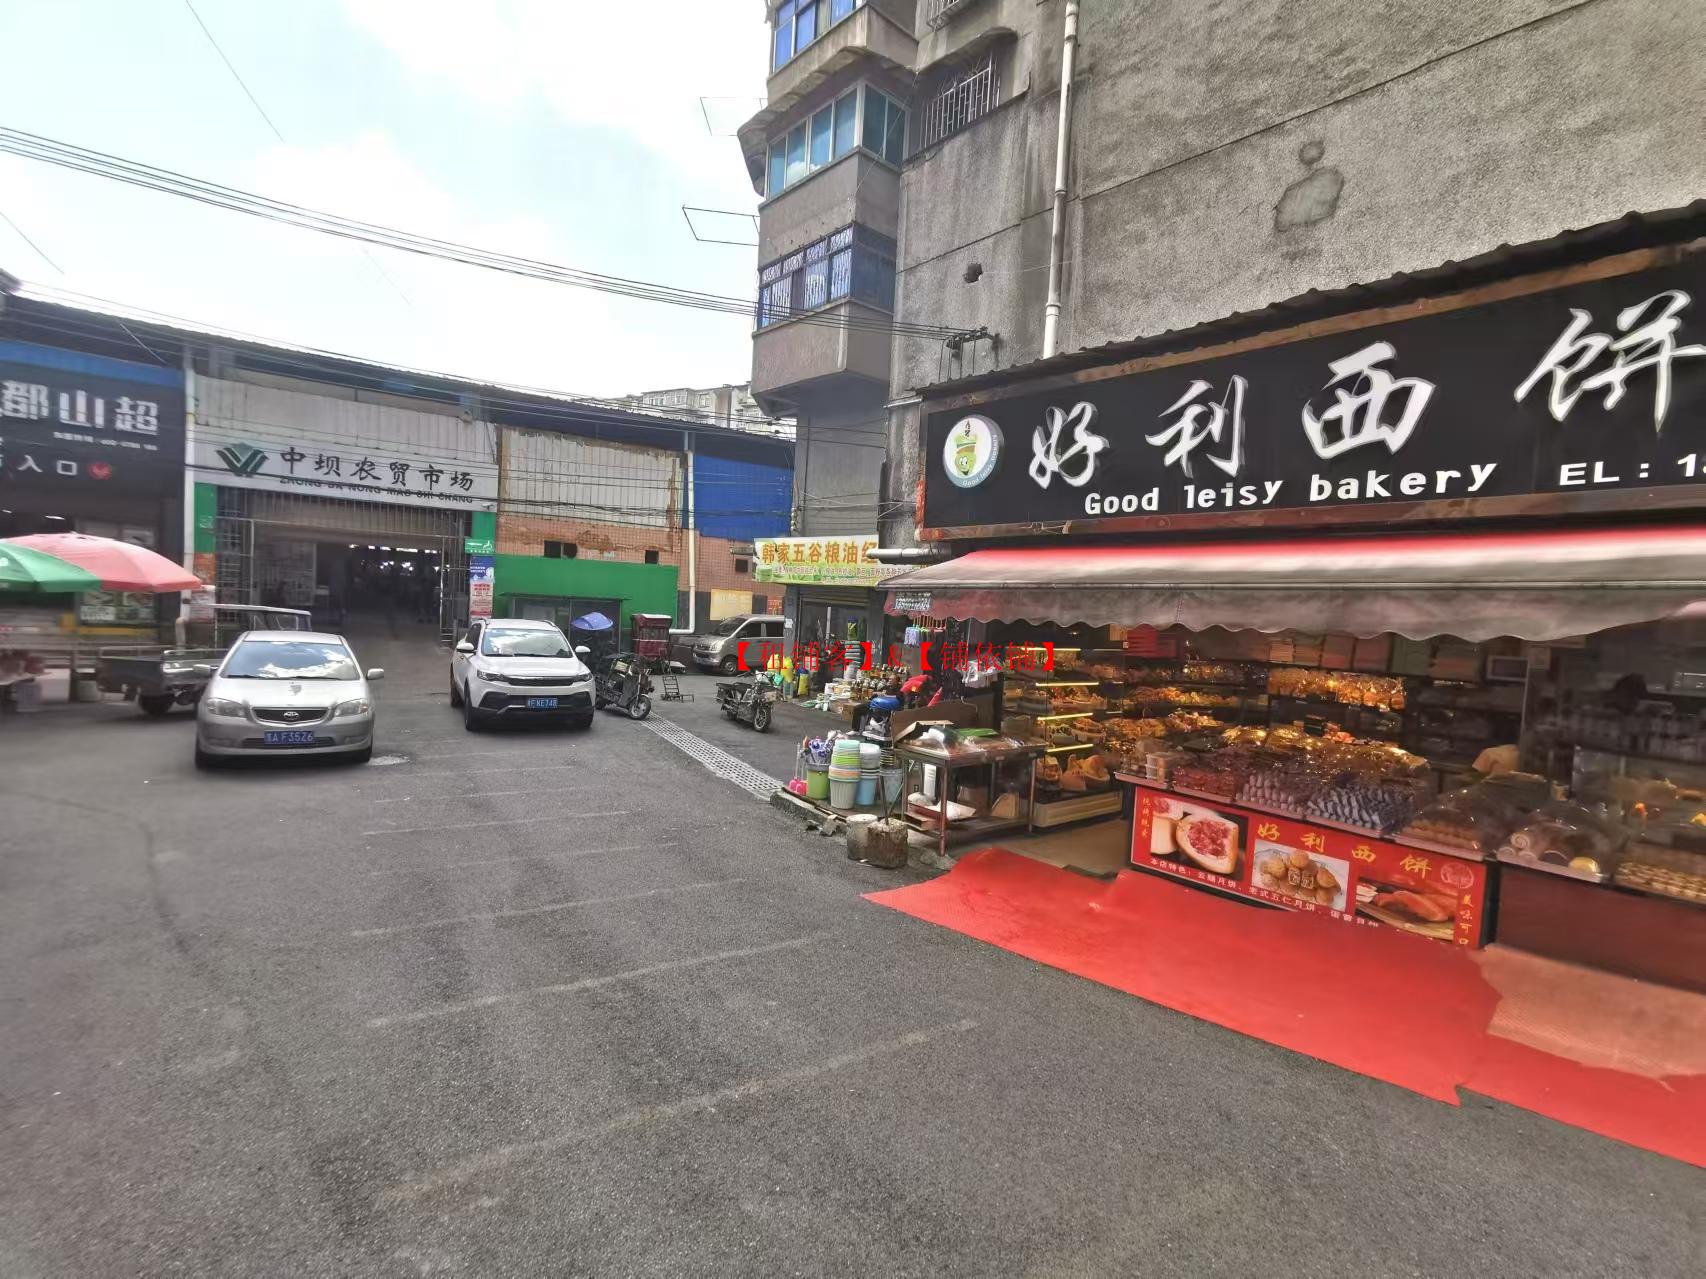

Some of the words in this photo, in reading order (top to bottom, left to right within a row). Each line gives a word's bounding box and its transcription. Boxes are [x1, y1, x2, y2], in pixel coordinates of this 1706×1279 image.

[1029, 289, 1706, 490] 好利西饼
[0, 454, 78, 476] 入口
[280, 446, 474, 491] 中坝农贸市场
[1085, 487, 1160, 515] Good
[1183, 472, 1283, 508] leisy
[1309, 462, 1498, 502] bakery
[1677, 453, 1706, 477] 1
[1258, 822, 1432, 879] 好利西饼
